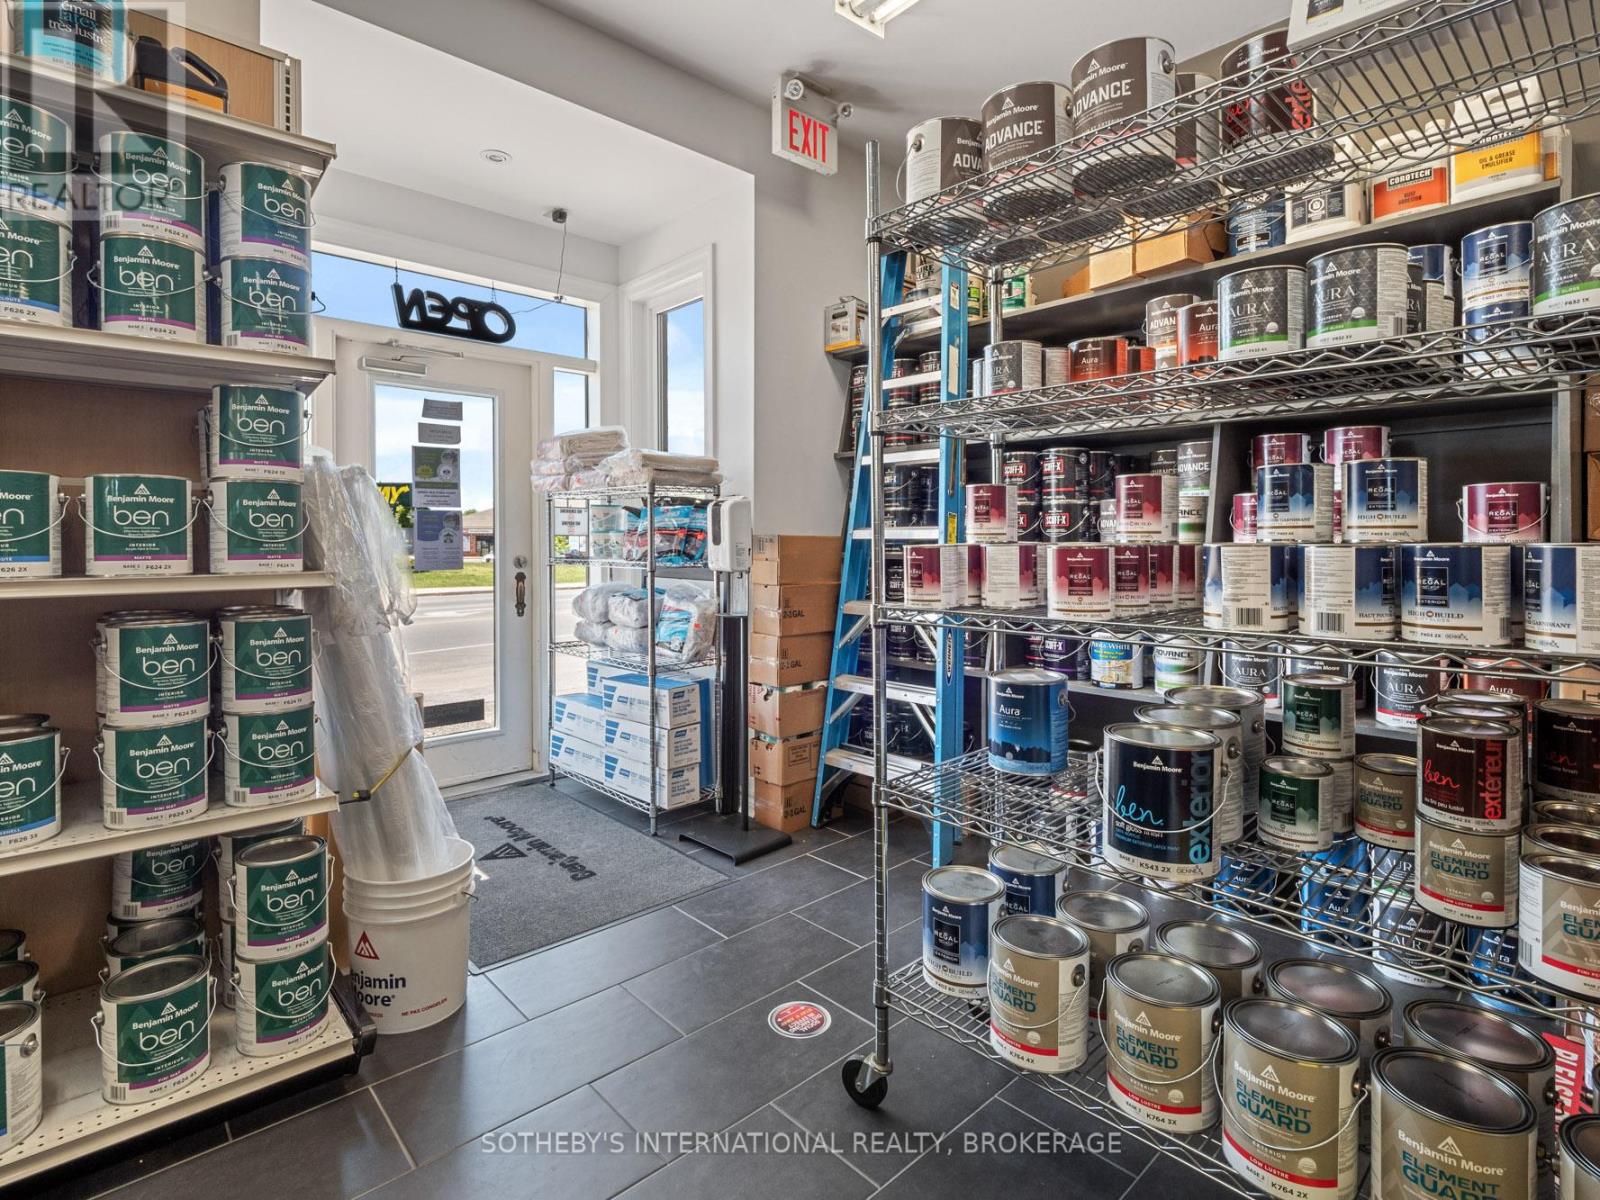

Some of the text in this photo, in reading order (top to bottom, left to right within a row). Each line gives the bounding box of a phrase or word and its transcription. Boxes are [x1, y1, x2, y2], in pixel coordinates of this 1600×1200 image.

[1099, 62, 1127, 76] Moore
[1072, 80, 1132, 120] ADVANCE
[986, 104, 1038, 128] Benjamin Moore
[787, 105, 830, 164] EXIT
[957, 137, 983, 148] Benjam
[985, 121, 1043, 152] ADVANCE
[125, 152, 166, 168] Benjamin
[953, 153, 983, 169] ADVA
[1478, 156, 1488, 164] OIL
[1481, 158, 1513, 170] EMULSIFIER
[132, 163, 186, 195] ben
[1389, 169, 1432, 187] COROTECH
[257, 182, 291, 198] Benjamin
[264, 192, 306, 224] ben
[113, 255, 180, 270] Benjamin Moore
[119, 265, 174, 292] ben
[243, 276, 278, 286] Benjamin
[1335, 267, 1361, 278] Moore
[1251, 285, 1275, 294] Moore
[1313, 285, 1357, 304] AURA
[249, 286, 296, 312] ben
[1228, 301, 1271, 318] AURA
[1150, 316, 1176, 332] ADVAN
[1081, 356, 1099, 365] Aura
[231, 403, 290, 415] Benjamin Moore
[236, 413, 285, 435] ben
[1003, 464, 1024, 475] SCUFF-X
[1368, 486, 1394, 494] REGAL
[107, 494, 175, 506] Benjamin Moore
[242, 499, 296, 509] Benjamin Moore
[113, 505, 169, 526] ben
[248, 508, 294, 528] ben
[1045, 514, 1067, 526] SCUFF-X
[1488, 508, 1517, 517] REGAL
[1069, 570, 1092, 580] REGAL
[1418, 577, 1447, 587] REGAL
[792, 609, 805, 618] GAL
[1407, 608, 1465, 620] HIGH BUILD
[135, 643, 200, 656] Benjamin Moore
[249, 636, 305, 647] Benjamin Moore
[142, 656, 196, 676] ben
[255, 648, 301, 667] ben
[790, 659, 802, 668] GAL
[1231, 655, 1270, 664] Benjamin Moore
[1235, 667, 1266, 677] AURA
[1298, 664, 1323, 672] Benjamin
[1383, 669, 1428, 679] Benjamin Moore
[1386, 682, 1425, 695] AURA
[1489, 684, 1515, 696] Aura
[999, 704, 1021, 716] Aura
[251, 726, 307, 741] Benjamin Moore
[129, 742, 196, 760] Benjamin Moore
[257, 740, 304, 760] ben
[12, 759, 42, 771] Moore
[136, 757, 190, 779] ben
[1132, 761, 1182, 774] Benjamin Moore
[1424, 759, 1461, 789] ben
[1480, 740, 1503, 819] extérieur
[794, 805, 807, 817] GAL
[1114, 785, 1164, 825] ben
[1182, 752, 1212, 865] exterior
[1359, 795, 1403, 811] GUARD
[1429, 840, 1490, 860] Benjamin Moore
[151, 854, 195, 877] ben
[525, 838, 597, 882] Benjamin
[1139, 862, 1172, 873] K543 2X
[1385, 858, 1412, 871] AUR
[1430, 850, 1490, 869] ELEMENT
[1430, 860, 1490, 880] GUARD
[260, 873, 318, 894] Benjamin Moore
[266, 889, 314, 913] ben
[1006, 902, 1029, 913] REGAL
[1560, 900, 1600, 917] Benjam
[1562, 913, 1600, 927] ELEM
[934, 928, 959, 943] REGAL
[1563, 924, 1600, 940] GUA
[1391, 935, 1424, 950] AUR
[271, 960, 324, 990] Benjamin Moore
[352, 970, 407, 990] njamin
[948, 967, 973, 977] BUILD
[991, 974, 1037, 1001] ELEMENT
[1013, 974, 1040, 988] Moore
[278, 978, 322, 1010] ben
[355, 990, 393, 1008] oore
[991, 982, 1037, 1013] GUARD
[131, 1000, 199, 1032] Benjamin Moore
[1113, 1009, 1181, 1042] Benjamin Moore
[139, 1020, 194, 1054] ben
[1116, 1025, 1178, 1056] ELEMENT
[1009, 1049, 1025, 1062] K764
[1116, 1037, 1179, 1070] GUARD
[1234, 1060, 1316, 1103] Benjamin Moore
[1128, 1092, 1162, 1111] LOW LUSTRE
[1235, 1078, 1312, 1119] ELEMENT
[1146, 1111, 1178, 1127] K764 3X
[1236, 1090, 1312, 1134] GUARD
[1252, 1140, 1287, 1161] EXTERIOR
[1397, 1128, 1505, 1177] Benjamin Moore
[1249, 1156, 1290, 1180] LOW LUSTRE
[1402, 1150, 1502, 1195] ELEMENT
[1271, 1181, 1309, 1199] K764 2X
